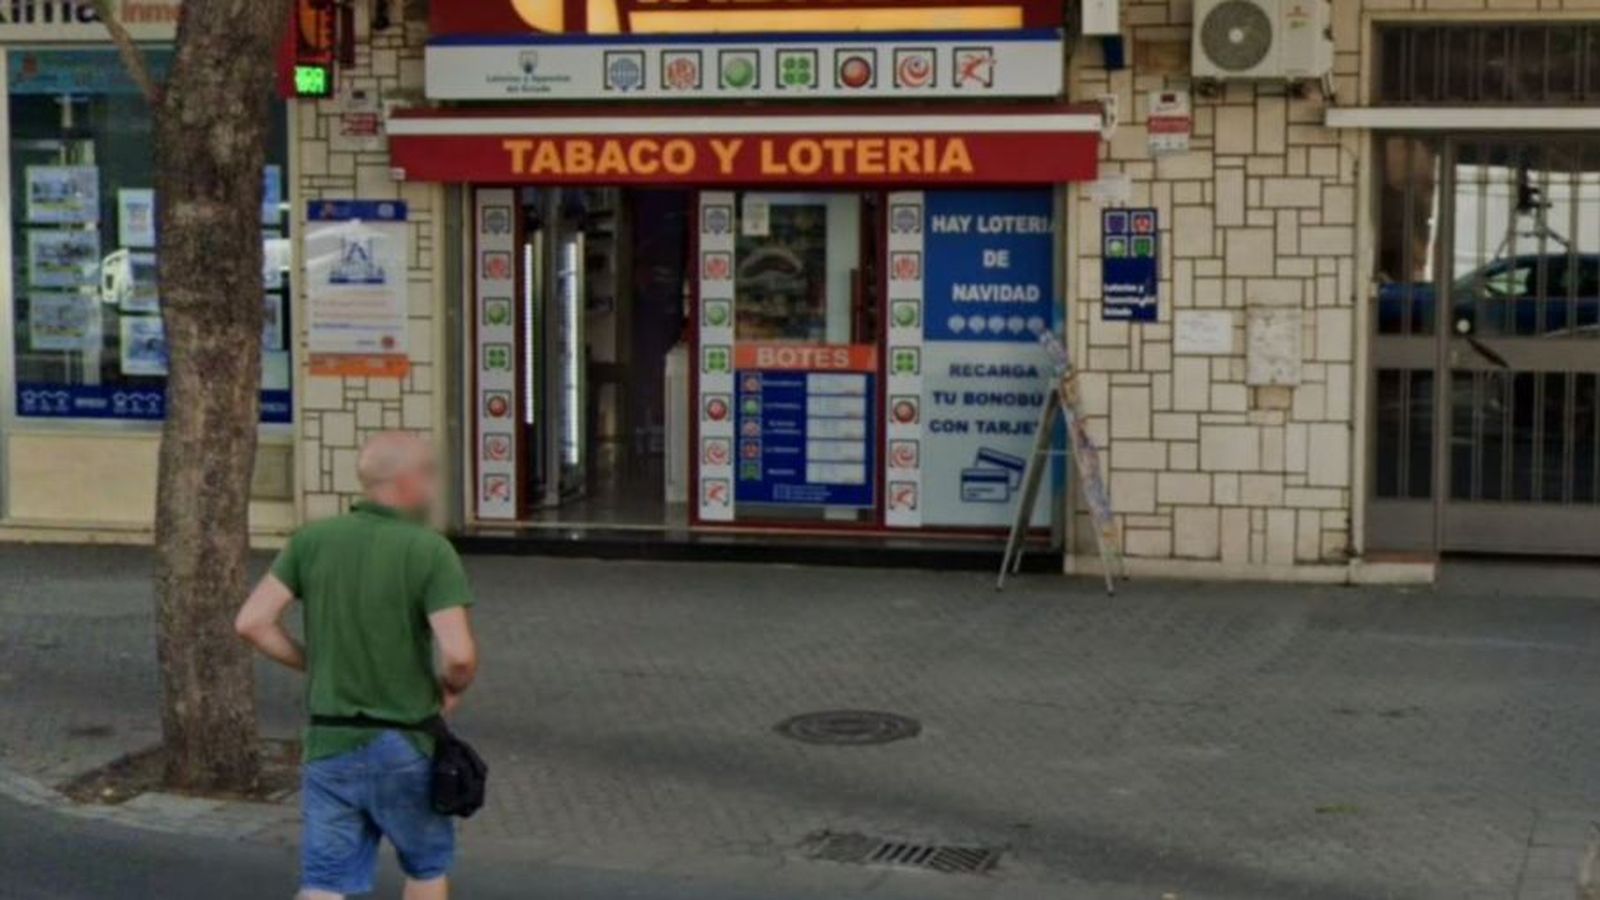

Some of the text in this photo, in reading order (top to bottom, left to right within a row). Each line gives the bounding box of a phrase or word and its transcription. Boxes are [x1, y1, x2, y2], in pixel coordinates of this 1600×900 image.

[503, 138, 974, 175] TABACO Y LOTERIA
[931, 214, 972, 233] HAY
[982, 250, 1010, 268] DE
[952, 283, 1041, 302] NAVIDAD
[757, 347, 850, 368] BOTES
[948, 362, 1039, 379] RECARGA
[933, 390, 957, 405] TU
[929, 420, 969, 433] CON
